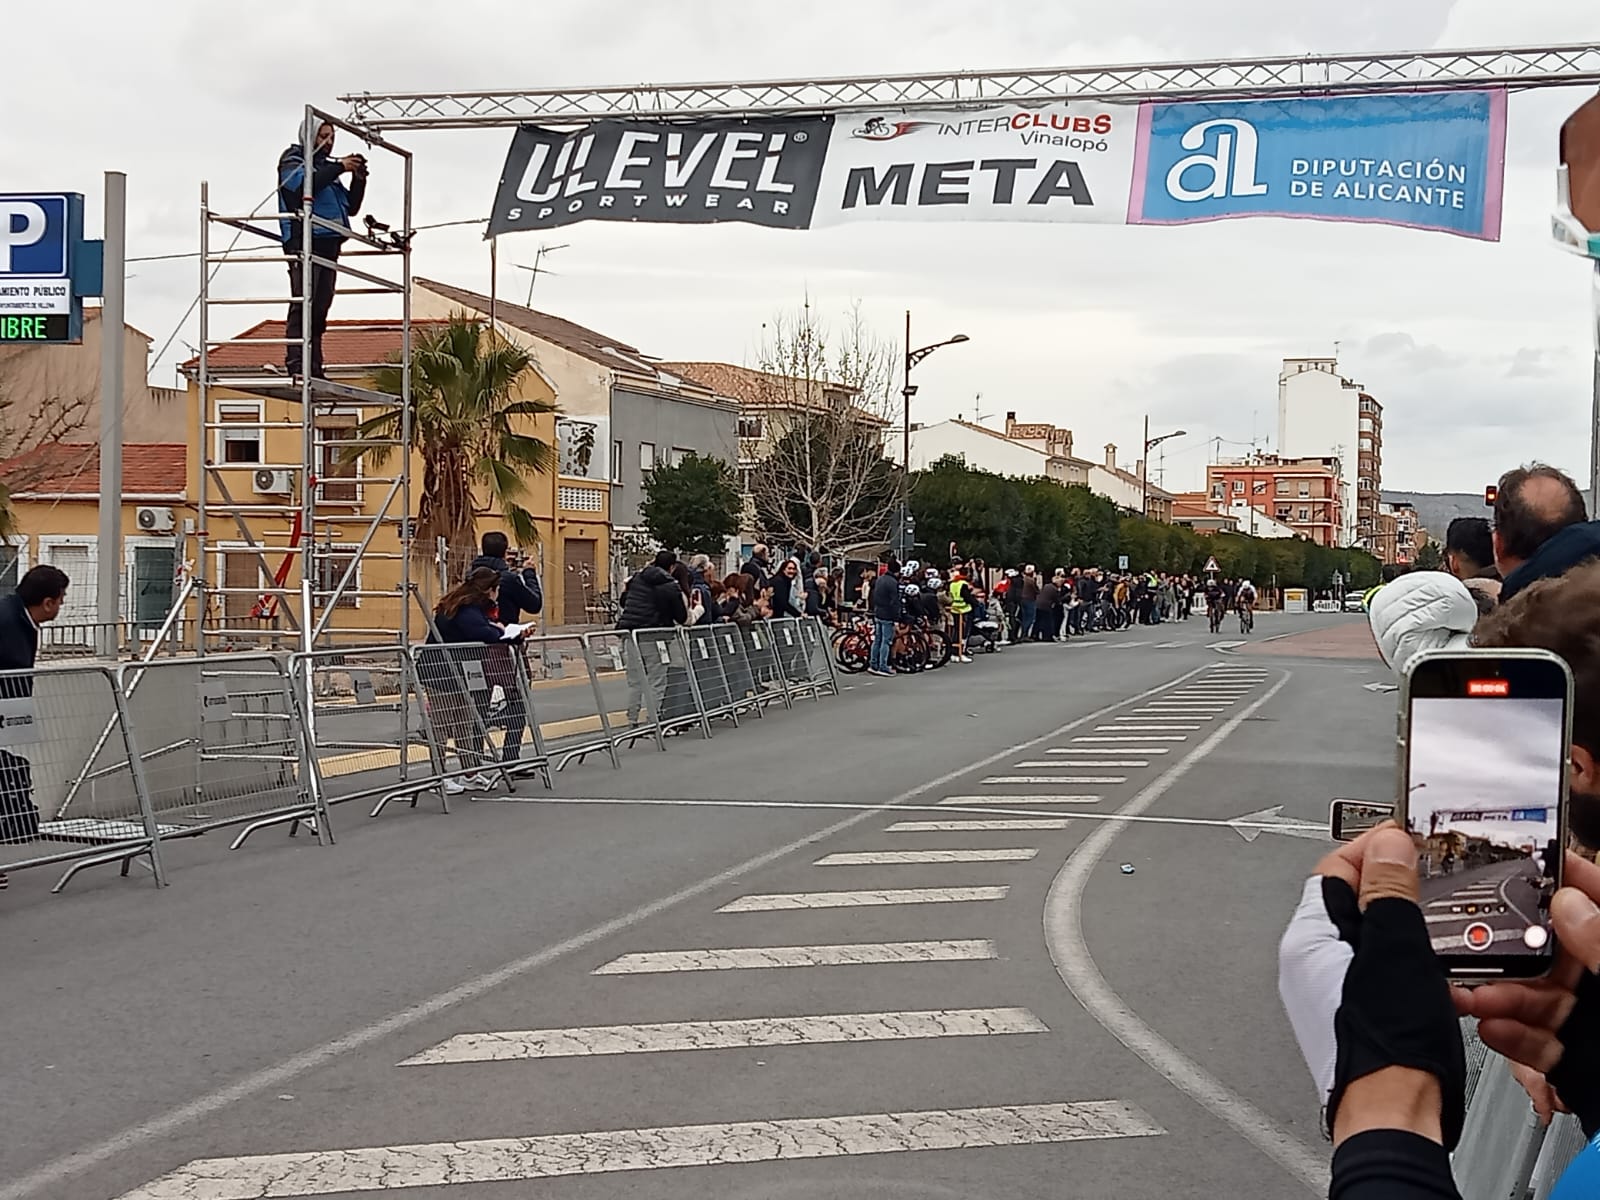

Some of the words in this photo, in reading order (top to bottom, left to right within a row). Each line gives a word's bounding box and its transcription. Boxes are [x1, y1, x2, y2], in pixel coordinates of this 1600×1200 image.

[938, 112, 1112, 136] INTERCLUBS
[1020, 130, 1109, 152] Vinalopó
[841, 158, 1095, 210] META
[1292, 157, 1466, 184] DIPUTACIÓN
[507, 194, 790, 221] SPORTWEAR
[1290, 180, 1324, 198] DE
[1333, 181, 1466, 210] ALICANTE
[0, 201, 47, 273] P
